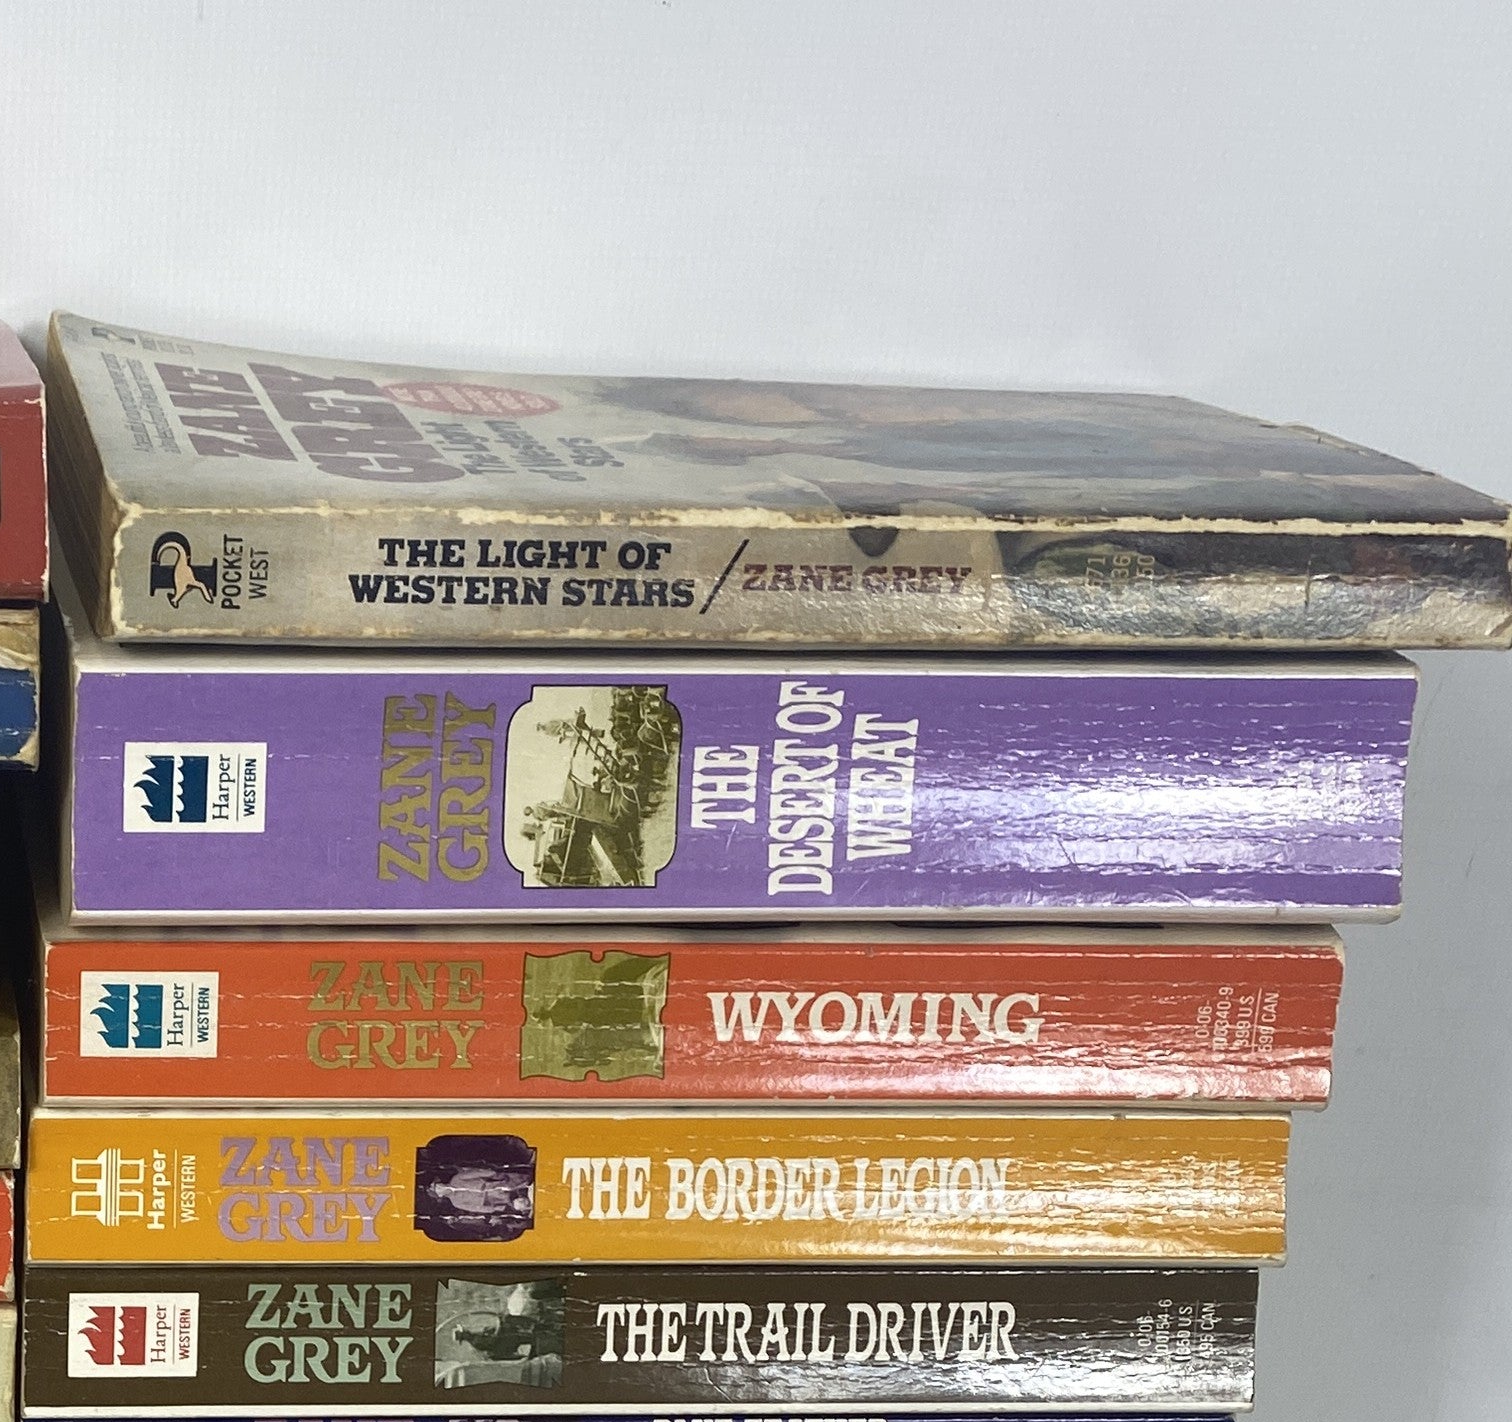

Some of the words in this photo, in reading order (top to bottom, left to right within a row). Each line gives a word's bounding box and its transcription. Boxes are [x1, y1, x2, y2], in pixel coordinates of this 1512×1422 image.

[221, 534, 243, 610] POCKET
[249, 548, 269, 600] WEST
[377, 538, 466, 570] THE
[477, 539, 610, 571] LIGHT
[618, 542, 672, 571] OF
[742, 564, 854, 592] ZANE
[862, 564, 971, 595] GREY
[349, 575, 549, 606] WESTERN
[561, 578, 696, 609] STARS
[776, 681, 844, 732] OF
[212, 754, 236, 821] Harper
[243, 758, 257, 817] WESTERN
[377, 694, 438, 882] ZANE
[436, 691, 497, 882] GREY
[690, 745, 760, 829] THE
[767, 738, 841, 897] DESERT
[848, 714, 920, 861] WHEAT
[707, 991, 1045, 1043] WYOMING
[147, 1149, 167, 1230] Harper
[596, 1302, 686, 1362] THE
[695, 1302, 840, 1361] TRAIL
[847, 1301, 1020, 1361] DRIVER
